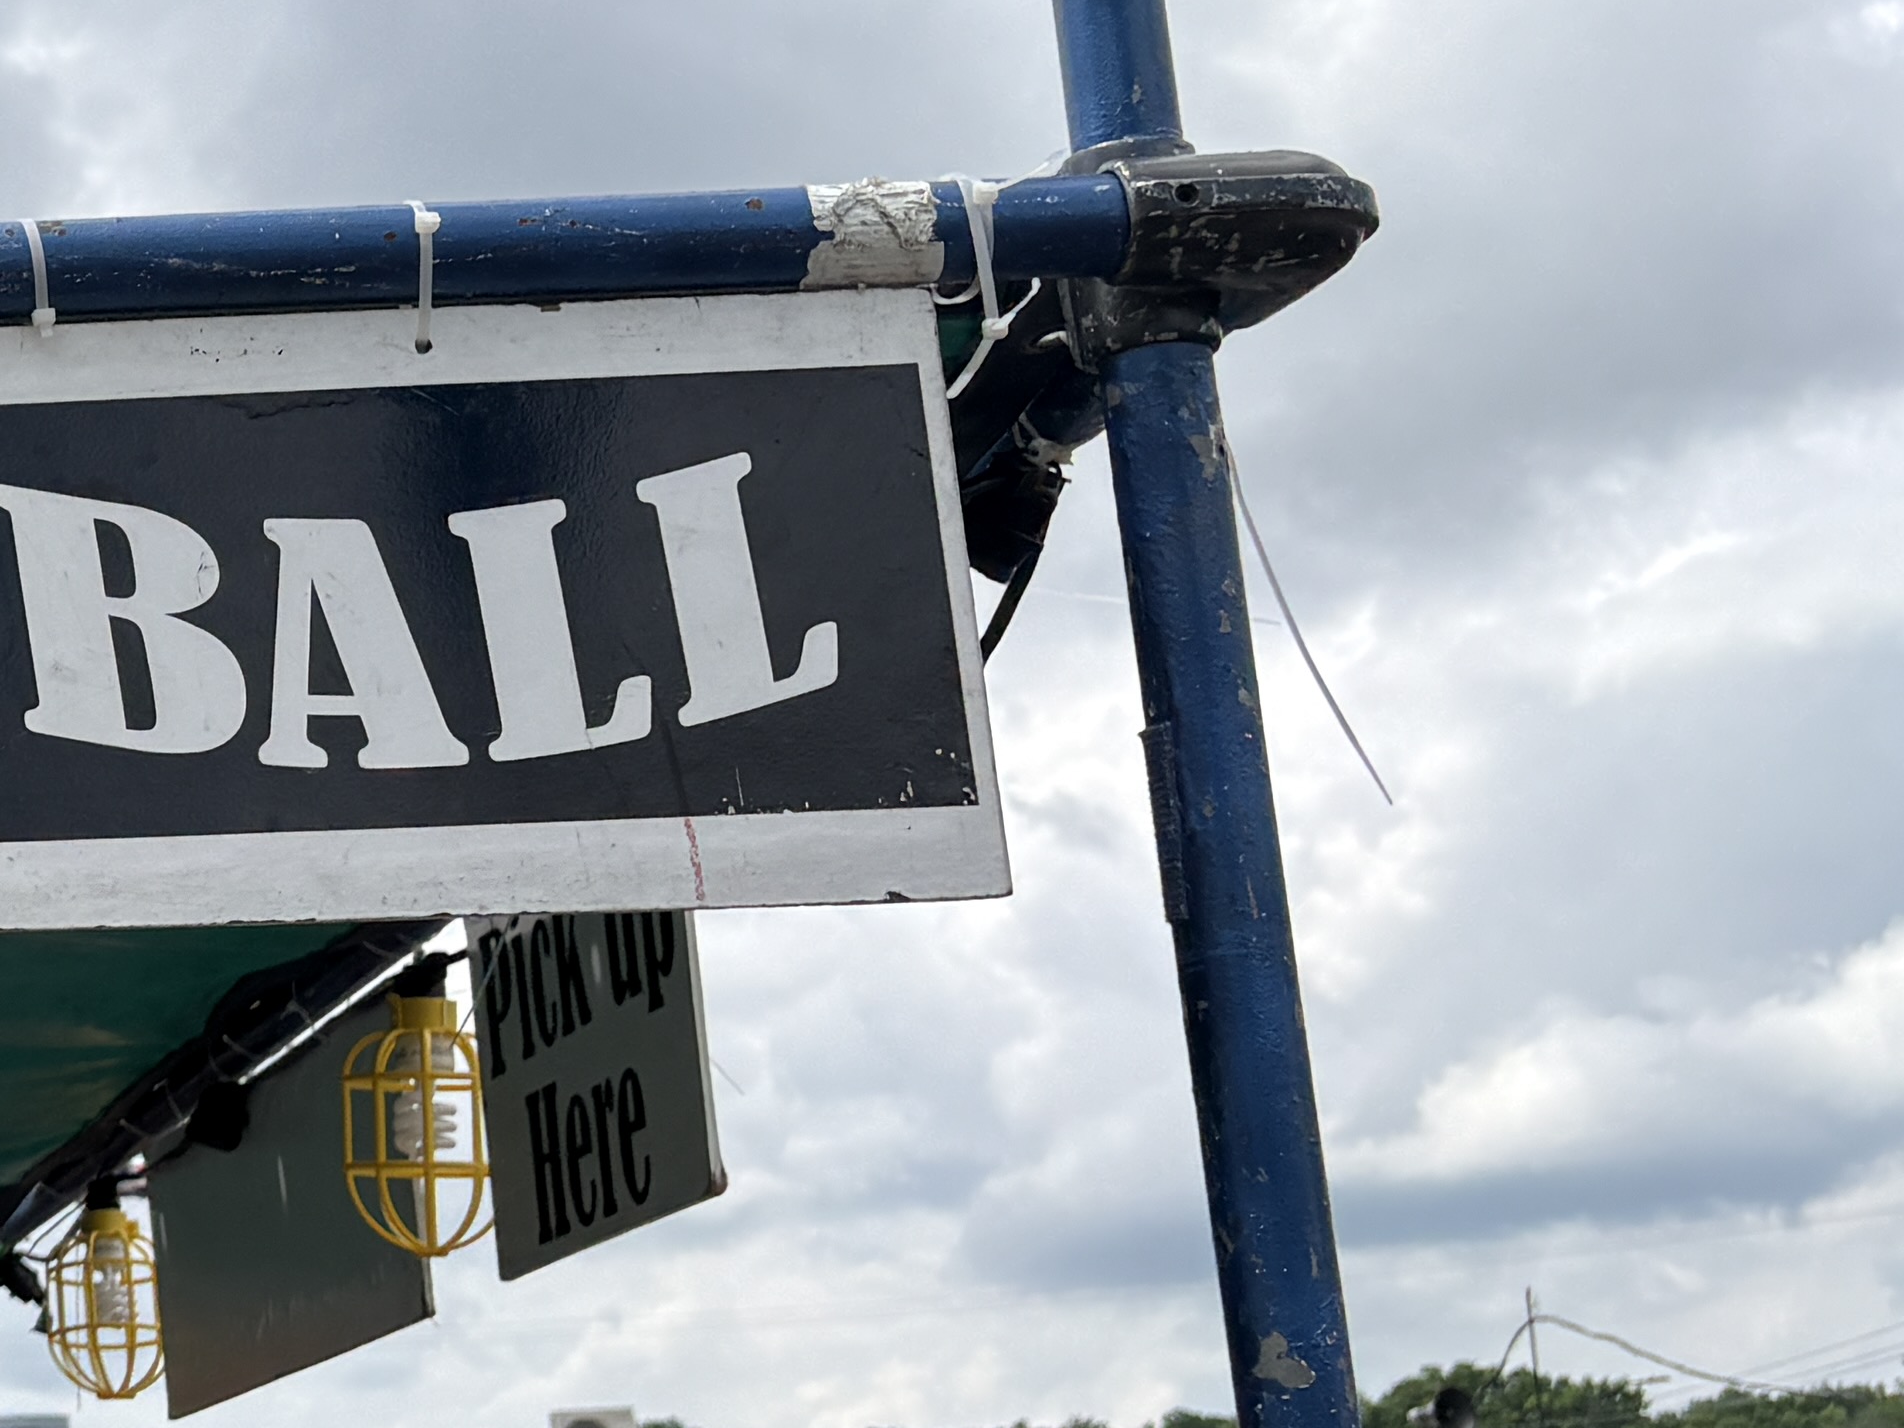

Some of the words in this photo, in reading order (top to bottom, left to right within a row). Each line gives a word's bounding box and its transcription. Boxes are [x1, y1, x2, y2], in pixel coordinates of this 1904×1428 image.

[478, 912, 593, 1081] Pick
[604, 912, 674, 1013] up
[525, 1067, 651, 1246] Here
